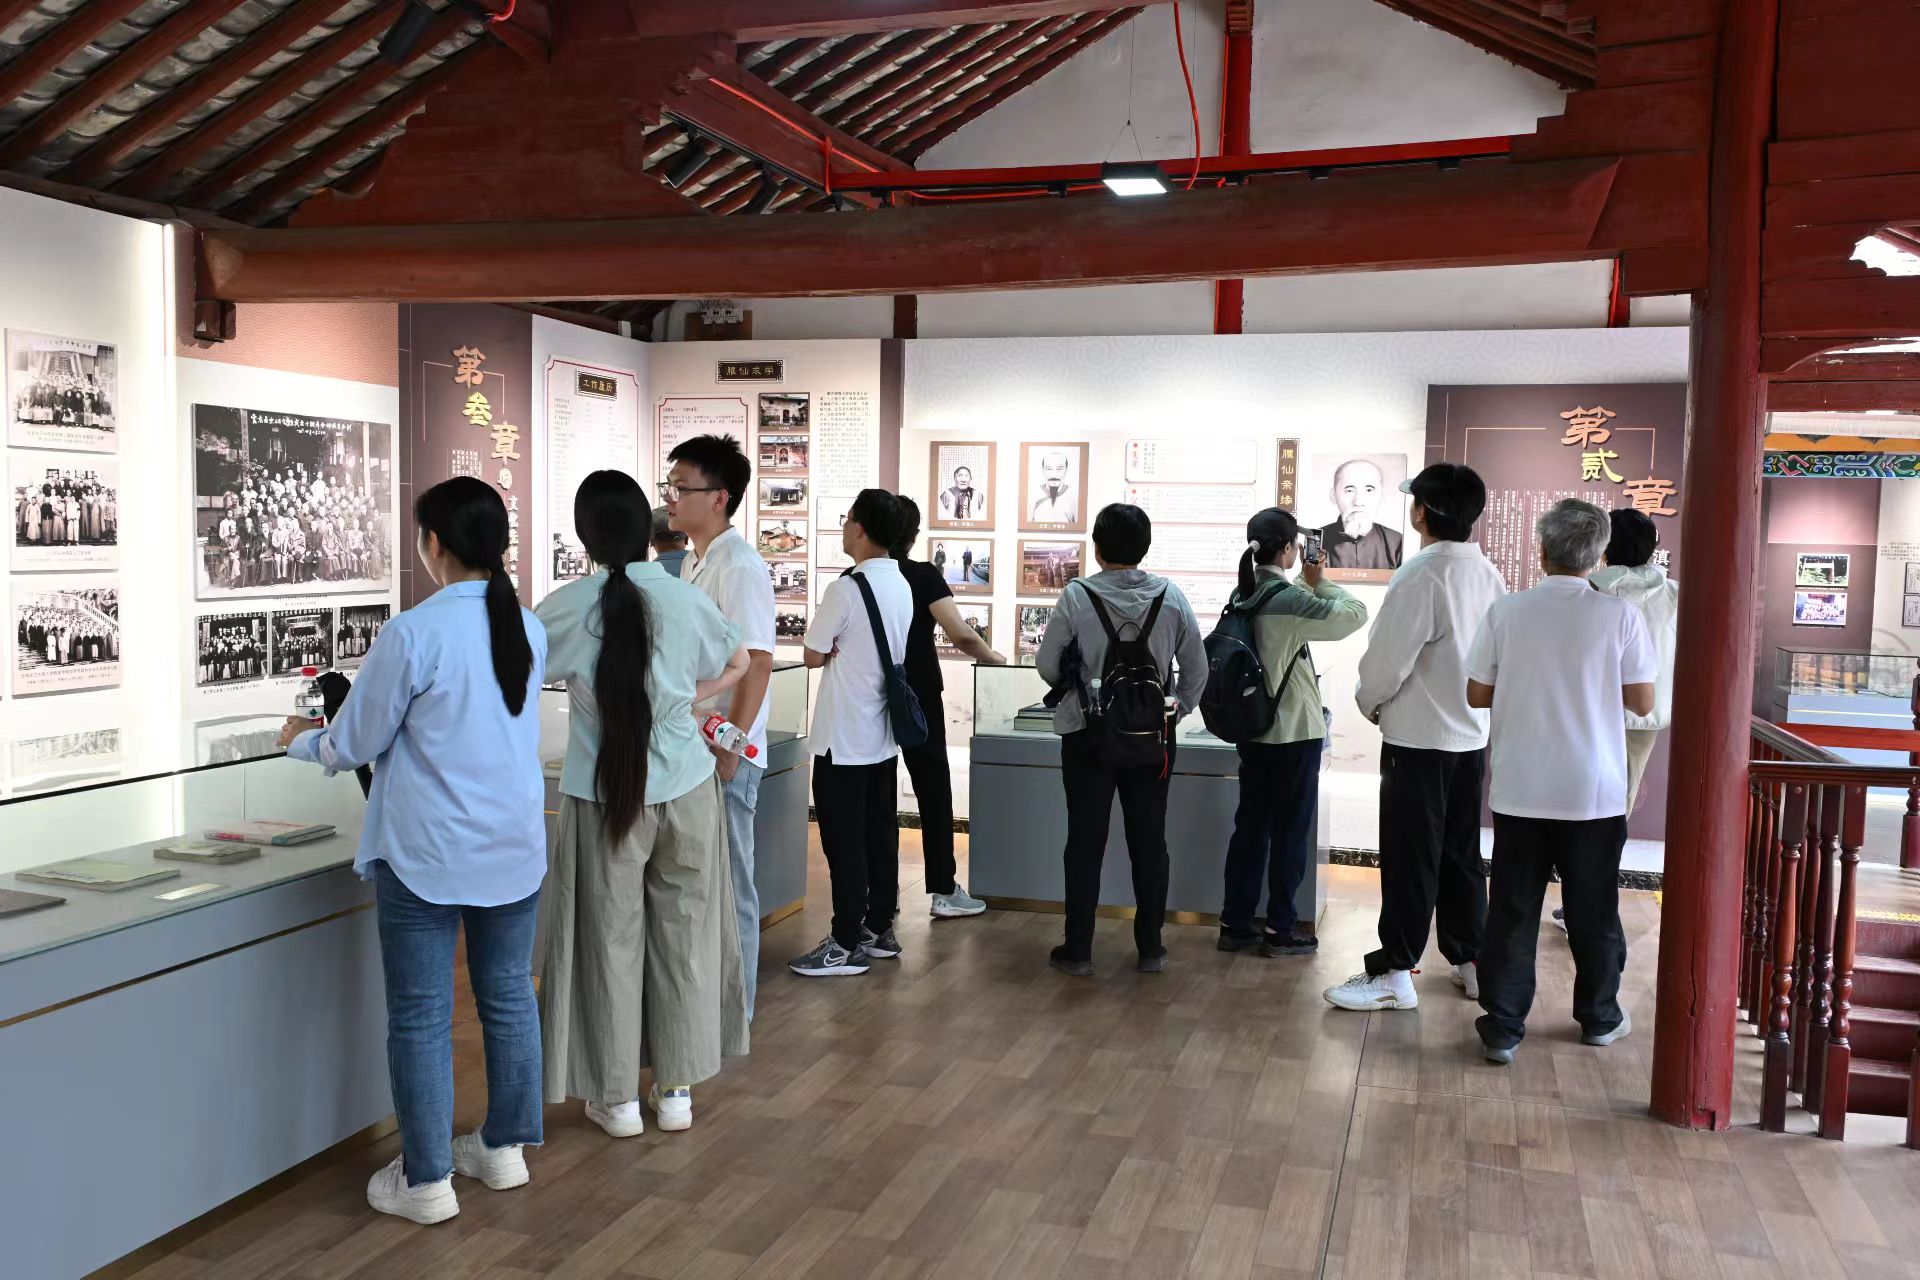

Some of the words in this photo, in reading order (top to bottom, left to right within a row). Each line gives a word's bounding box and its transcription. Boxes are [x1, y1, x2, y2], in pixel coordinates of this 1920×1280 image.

[453, 345, 521, 465] 第叁章
[1559, 405, 1679, 517] 第贰章
